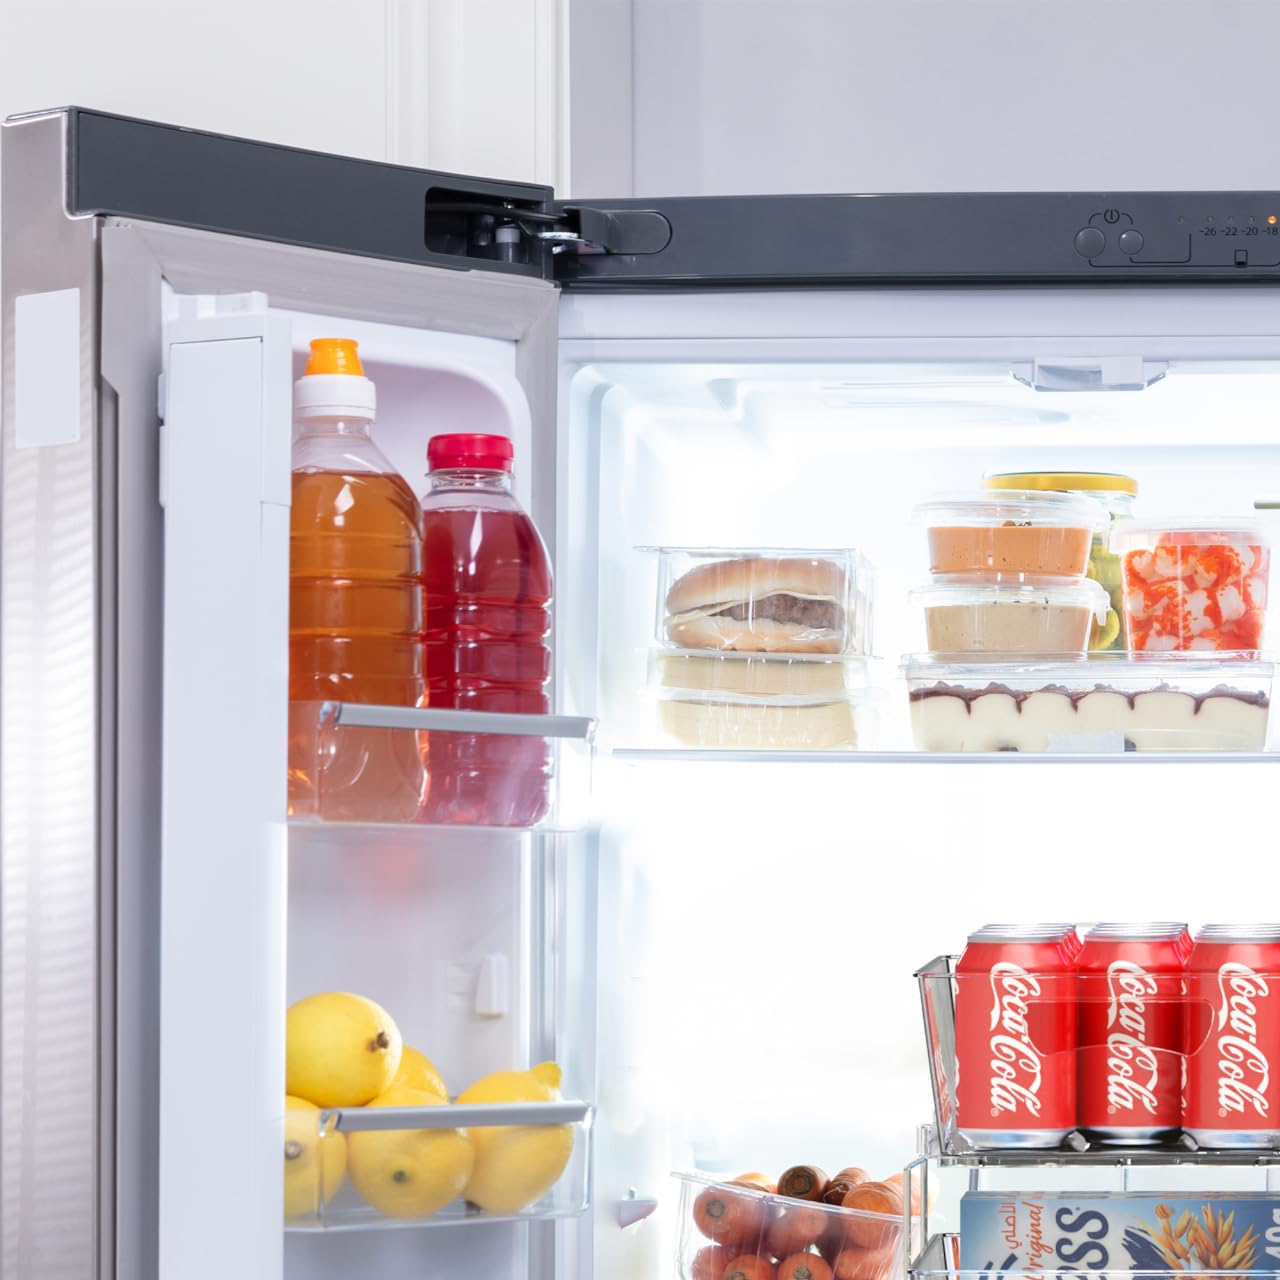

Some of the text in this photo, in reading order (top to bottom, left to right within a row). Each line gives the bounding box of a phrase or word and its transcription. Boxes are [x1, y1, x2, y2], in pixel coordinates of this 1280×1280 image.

[1199, 226, 1279, 236] -26 -22 -20 -18
[989, 961, 1043, 1118] Coca-Cola
[1106, 960, 1158, 1116] Coca-Cola
[1217, 962, 1270, 1118] Coca-Cola
